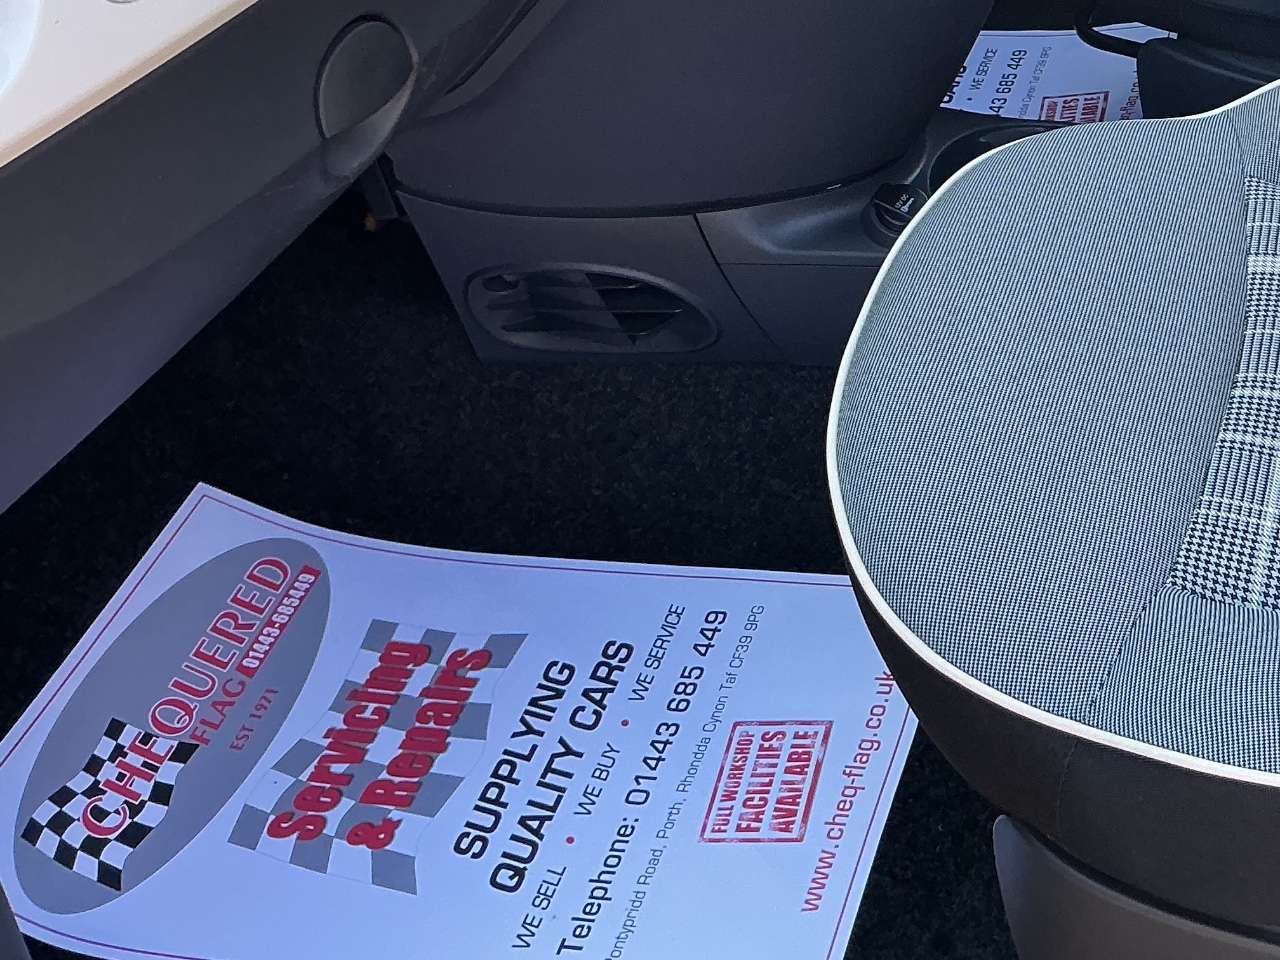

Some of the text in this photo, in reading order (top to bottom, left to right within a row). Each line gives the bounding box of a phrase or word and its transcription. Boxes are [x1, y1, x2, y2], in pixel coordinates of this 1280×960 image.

[996, 73, 1017, 94] 685
[1007, 49, 1028, 70] 449
[191, 572, 317, 746] FLAG 01443-685449
[730, 629, 755, 670] CF39
[742, 603, 766, 634] 9PG
[78, 557, 293, 839] CHEQUERED
[229, 687, 279, 752] EST 1971
[702, 694, 730, 734] Cynon
[717, 666, 739, 692] Taf
[266, 640, 432, 843] Servicing
[346, 647, 493, 850] & Repairs
[453, 658, 576, 860] SUPPLYING
[488, 638, 635, 894] QUALITY CARS
[512, 602, 686, 949] WE SELL WE BUY WE SERVICE
[556, 609, 728, 956] Telephone: 01443 685 449
[676, 736, 710, 794] Rhondda
[709, 729, 756, 835] FULL WORKSHOP
[734, 729, 788, 834] FACILITIES
[772, 730, 820, 833] AVAILABLE
[802, 670, 896, 913] www.cheq-flag.co.uk
[604, 890, 647, 960] ontypridd
